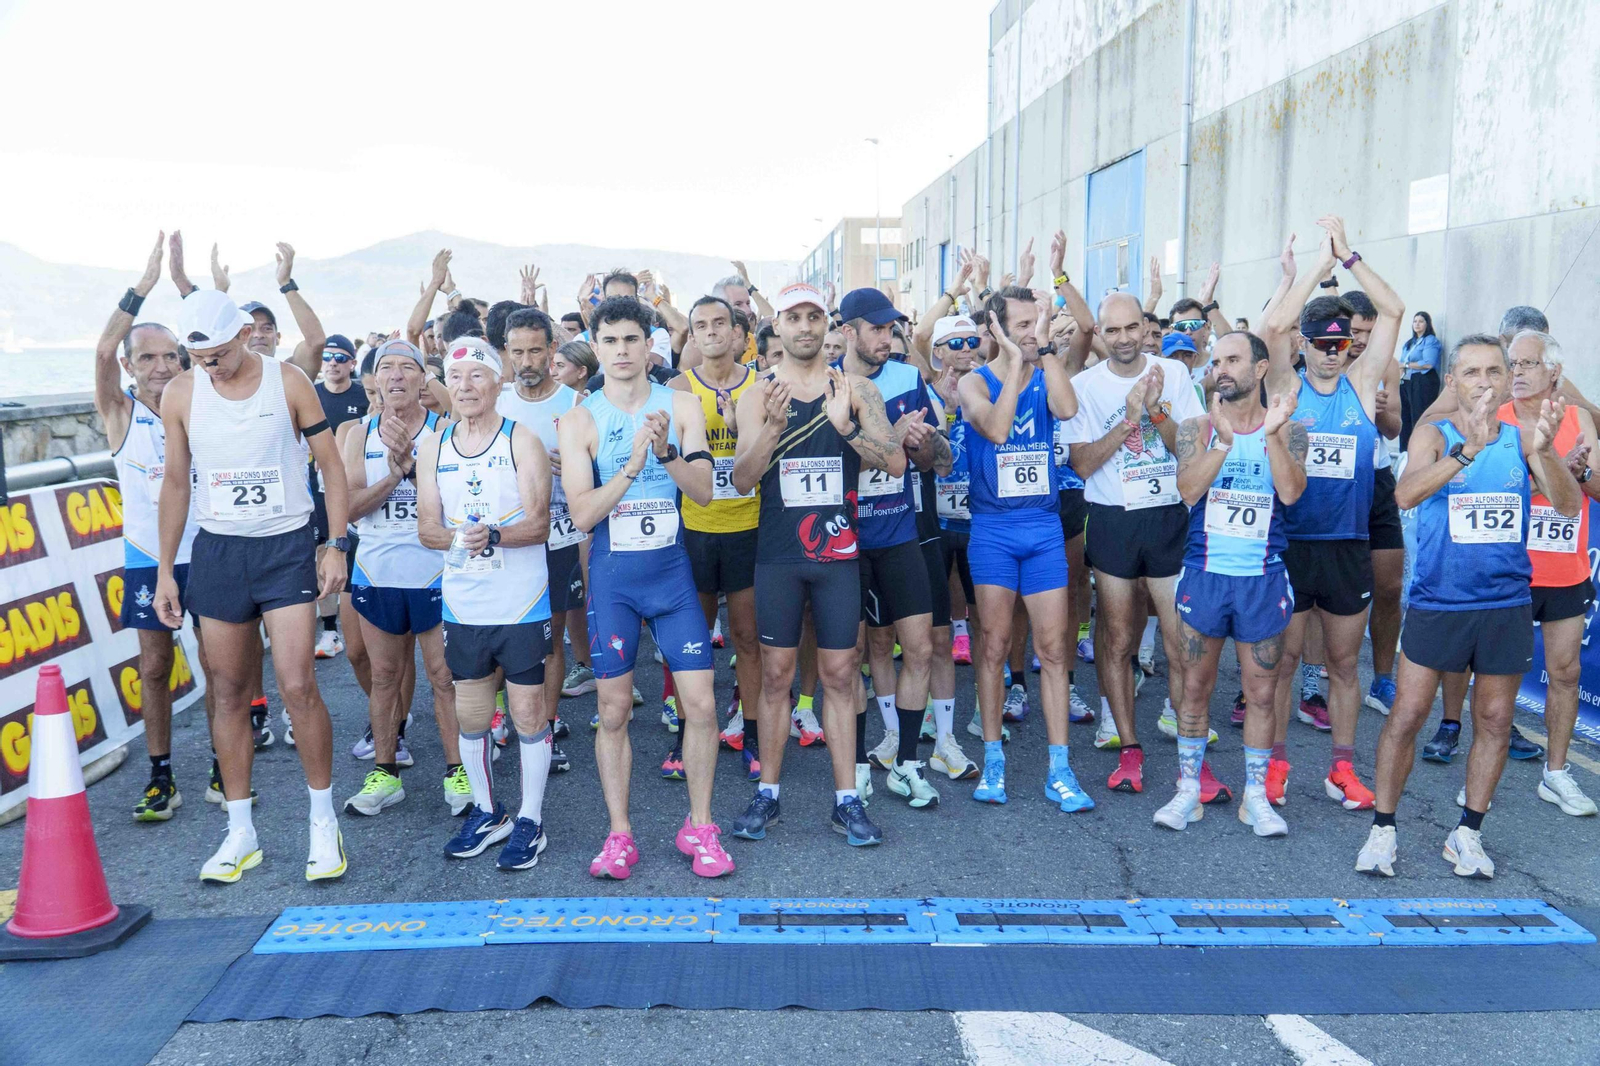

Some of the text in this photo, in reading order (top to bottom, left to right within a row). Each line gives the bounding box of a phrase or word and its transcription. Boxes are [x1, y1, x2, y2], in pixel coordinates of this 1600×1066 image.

[1312, 448, 1342, 466] 34
[212, 470, 279, 480] 10KMS ALFONSO MORO
[1014, 466, 1038, 484] 66
[1140, 466, 1162, 474] ALFONSO
[800, 473, 827, 492] 11
[1148, 478, 1162, 494] 3
[232, 485, 268, 506] 23
[1212, 490, 1230, 498] 10KMS
[1230, 493, 1256, 502] ALFONSO
[1256, 496, 1272, 504] MORO
[1452, 496, 1474, 504] 10KMS
[1475, 496, 1502, 504] ALFONSO
[632, 502, 658, 510] ALFONSO
[1227, 506, 1256, 526] 70
[1466, 510, 1515, 530] 152
[640, 516, 656, 536] 6
[1532, 521, 1574, 540] 156
[982, 902, 1081, 910] CRONOTEC
[500, 916, 698, 927] CRONOTEC
